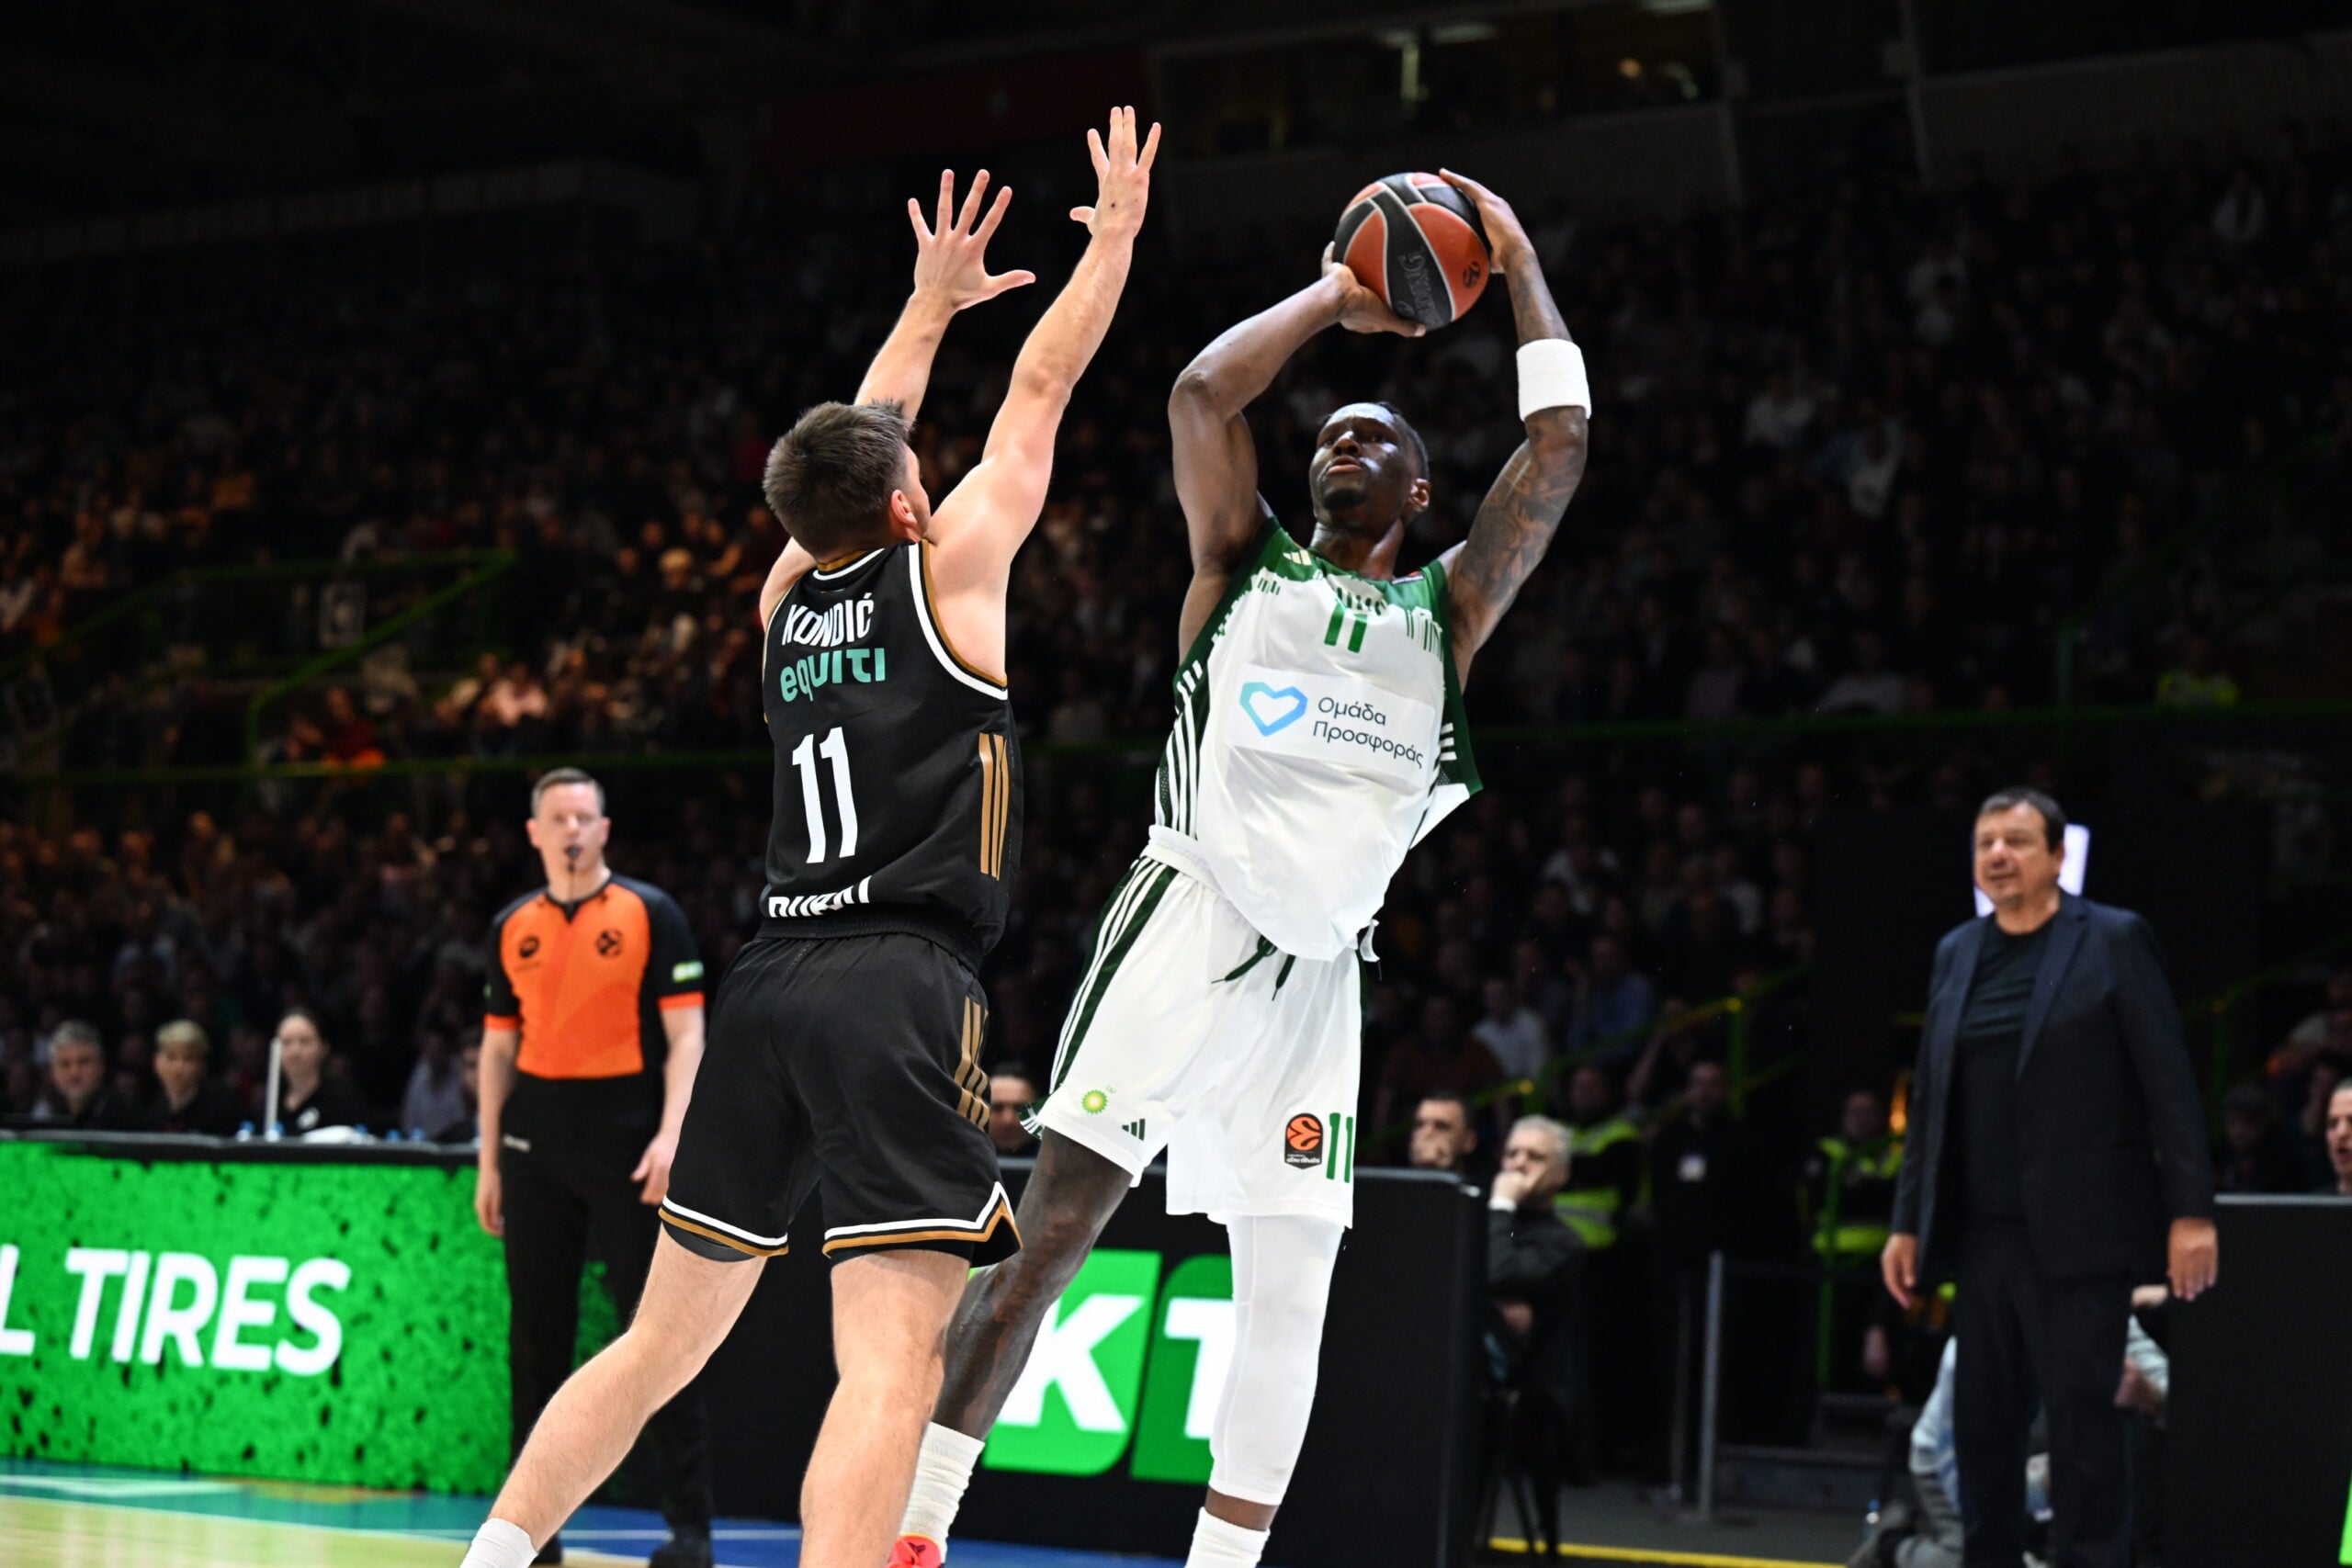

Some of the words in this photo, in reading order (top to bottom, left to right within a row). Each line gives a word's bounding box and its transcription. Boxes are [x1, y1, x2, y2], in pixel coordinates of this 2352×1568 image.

[782, 592, 875, 647] KONDIĆ
[1317, 696, 1386, 726] Ομάδα
[1312, 720, 1424, 769] Προσφοράς
[792, 727, 858, 863] 11
[1326, 1112, 1353, 1184] 11
[65, 1247, 351, 1376] TIRES
